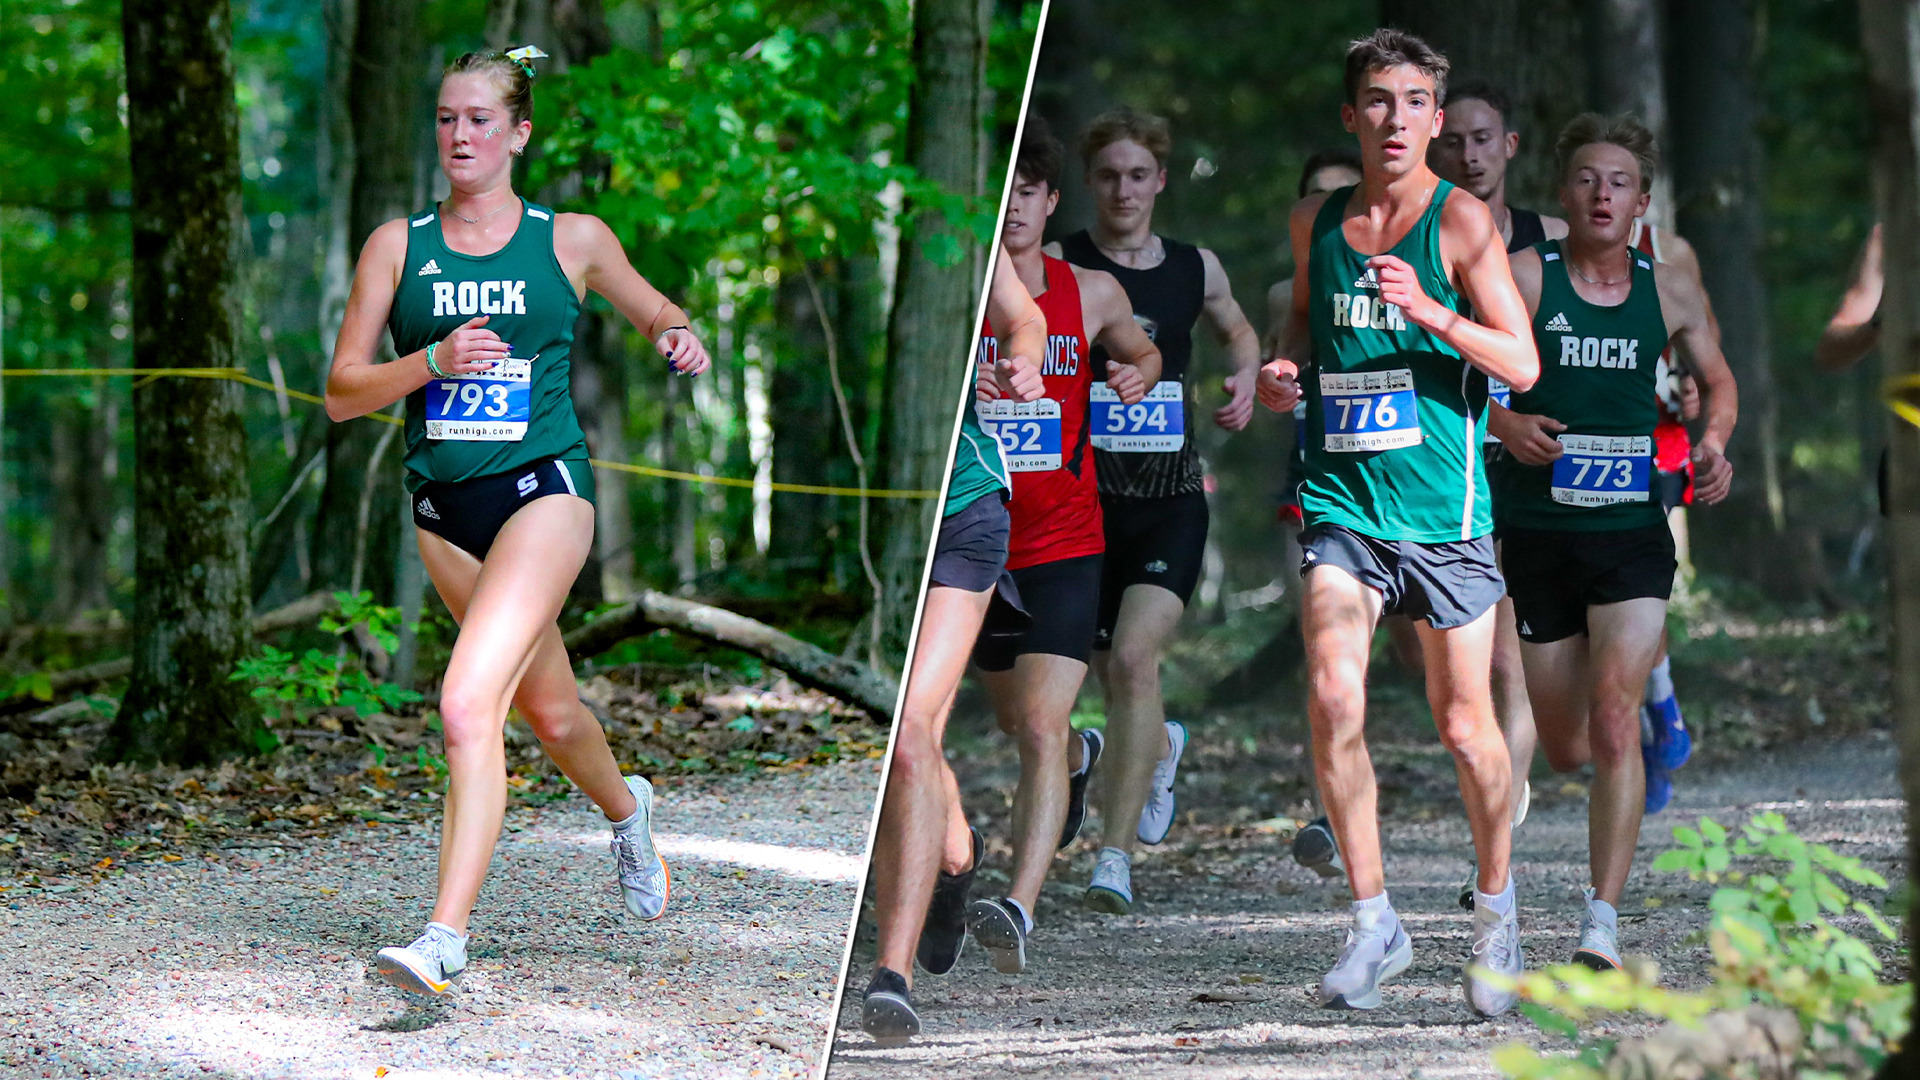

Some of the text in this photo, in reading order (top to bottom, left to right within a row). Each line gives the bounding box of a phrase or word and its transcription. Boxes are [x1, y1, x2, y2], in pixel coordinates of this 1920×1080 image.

[418, 268, 442, 276] adidas
[432, 280, 527, 317] ROCK
[1333, 293, 1406, 331] ROCK
[1545, 324, 1573, 332] adidas
[1560, 335, 1639, 369] ROCK
[440, 383, 509, 417] 793
[1335, 395, 1398, 430] 776
[449, 427, 513, 436] runhigh.com
[1106, 404, 1169, 432] 594
[1347, 437, 1405, 447] runhigh.com
[1008, 460, 1047, 469] igh.com
[1571, 457, 1633, 488] 773
